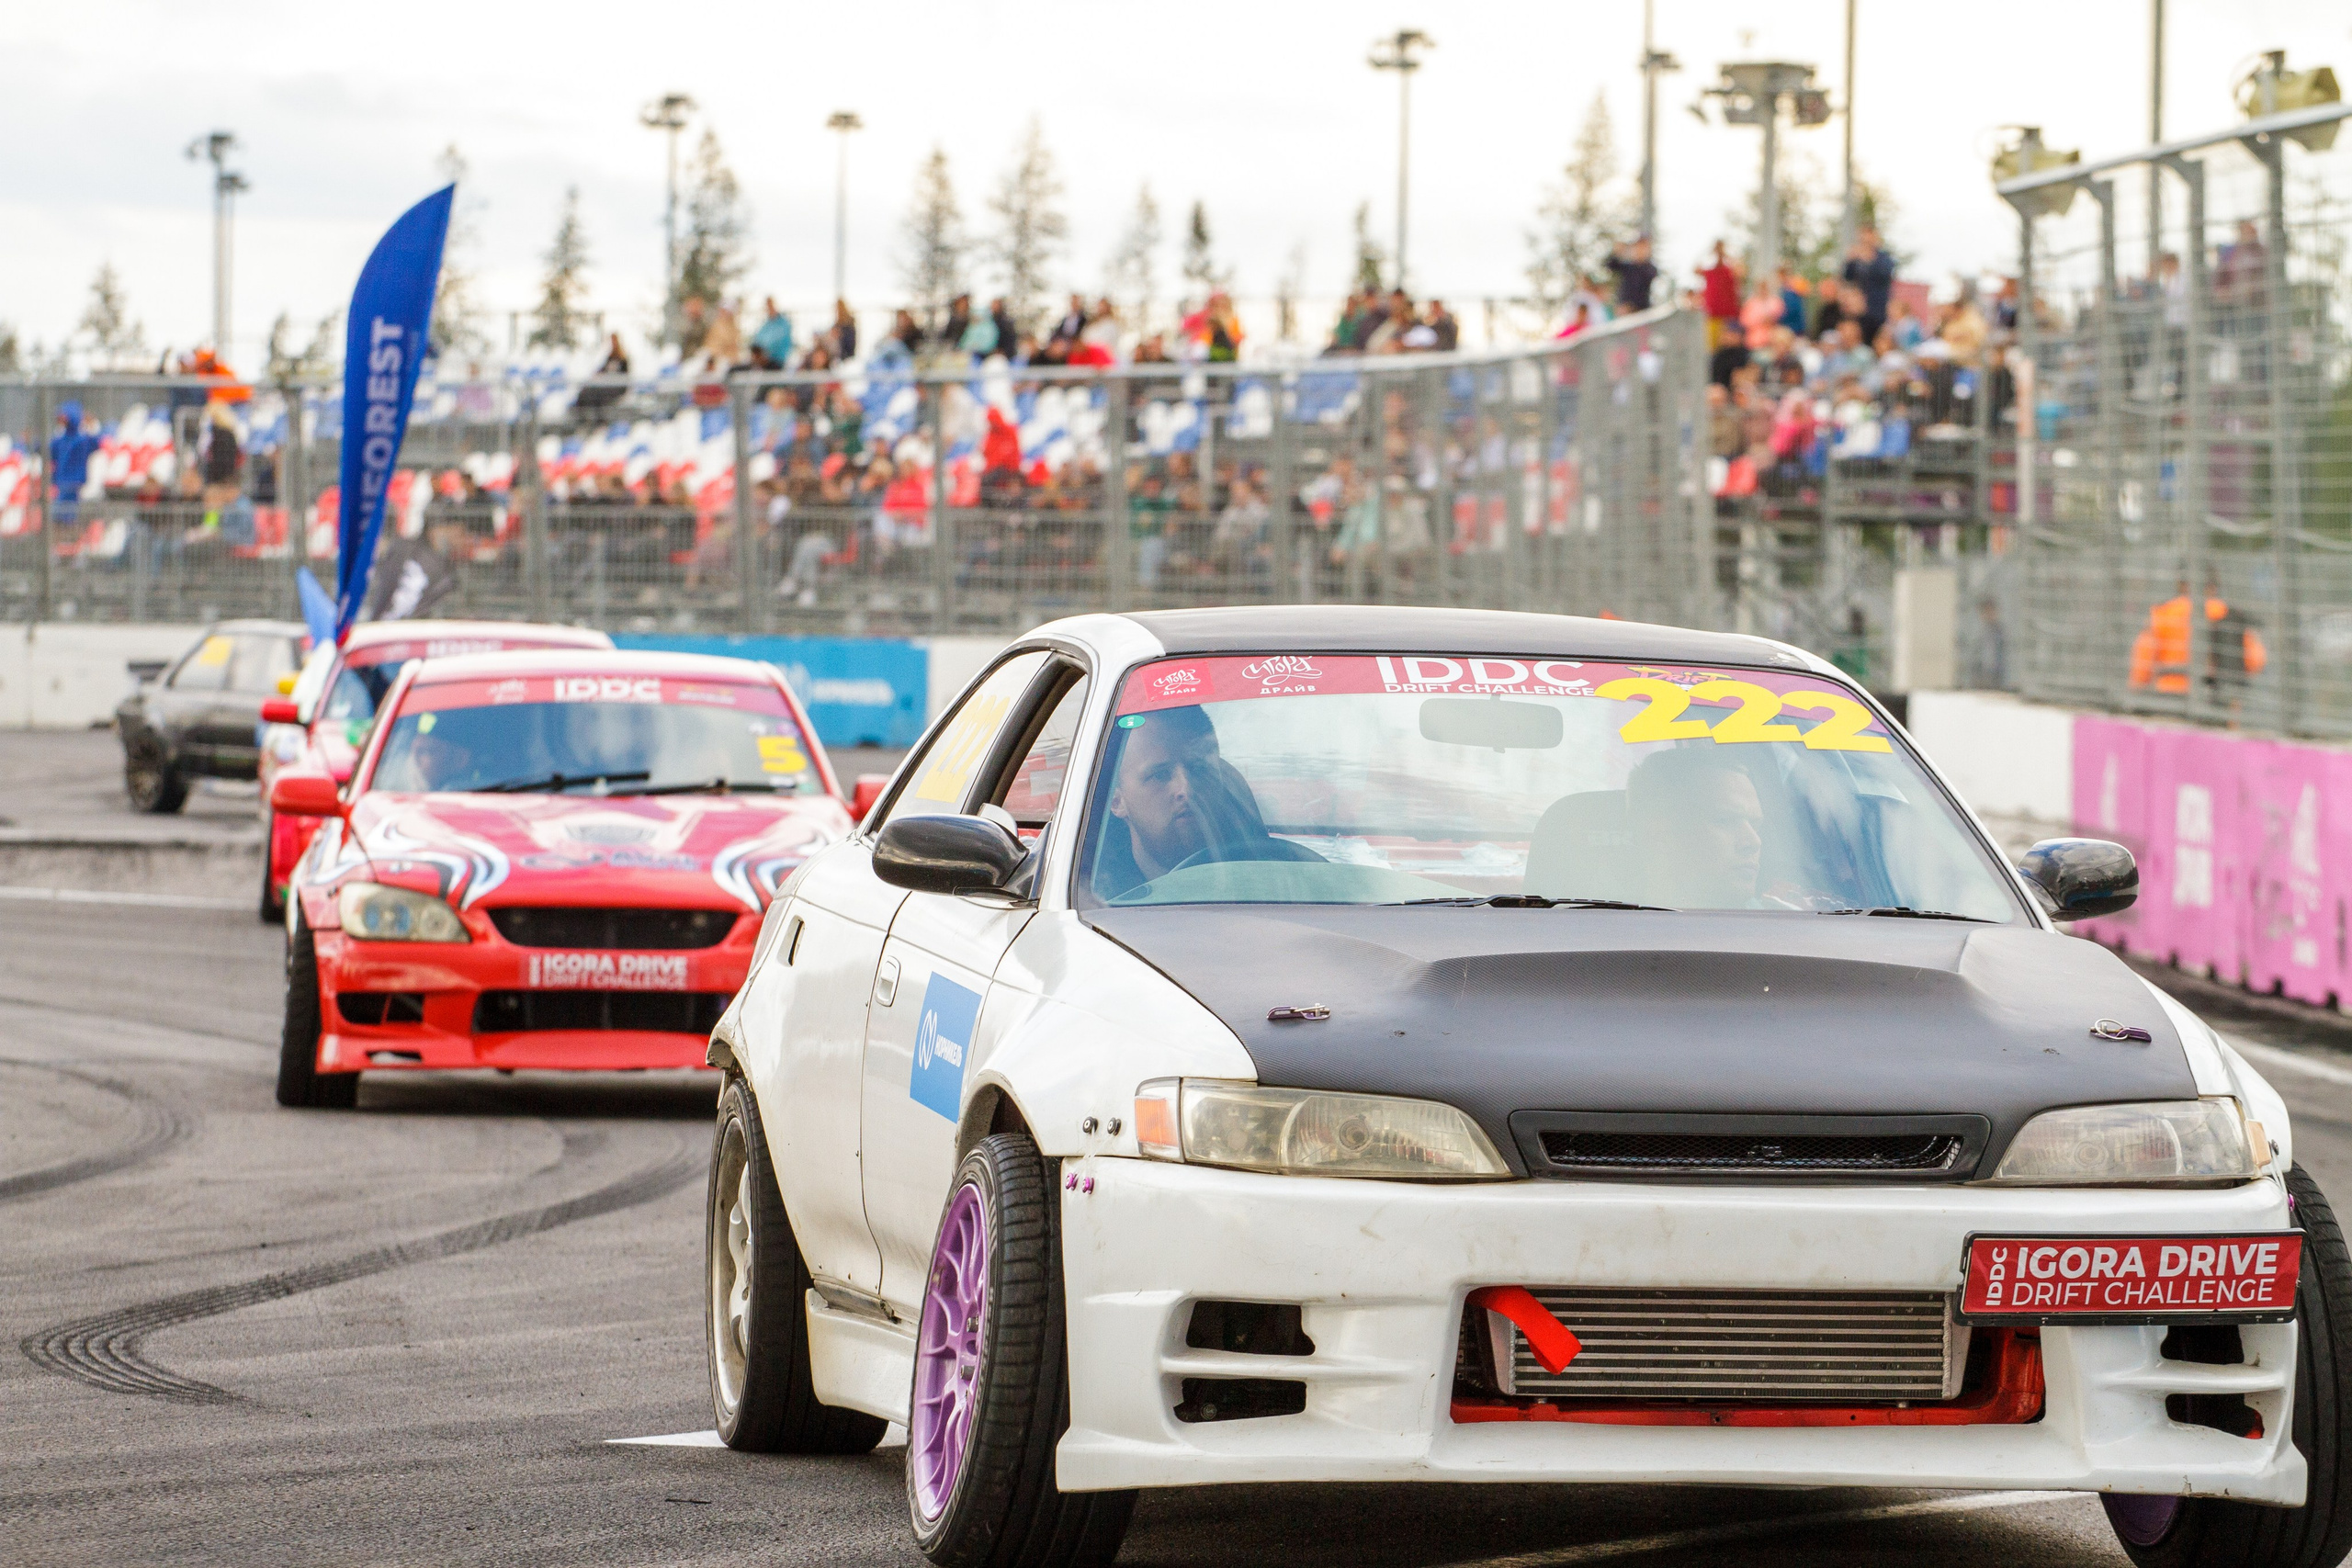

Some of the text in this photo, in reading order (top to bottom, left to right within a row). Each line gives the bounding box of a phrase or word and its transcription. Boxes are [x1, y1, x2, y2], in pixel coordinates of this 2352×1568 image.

[1375, 657, 1591, 687] IDDC
[1162, 687, 1197, 696] ДРАЙВ
[1260, 684, 1317, 695] ДРАЙВ
[1385, 682, 1596, 697] DRIFT CHALLENGE
[1594, 677, 1894, 753] 222
[757, 735, 807, 773] 5
[914, 694, 1011, 804] 222
[543, 953, 616, 976] IGORA
[618, 953, 687, 976] DRIVE
[1985, 1247, 2007, 1306] IDDC
[2016, 1243, 2280, 1280] IGORA DRIVE
[2011, 1278, 2276, 1306] DRIFT CHALLENGE
